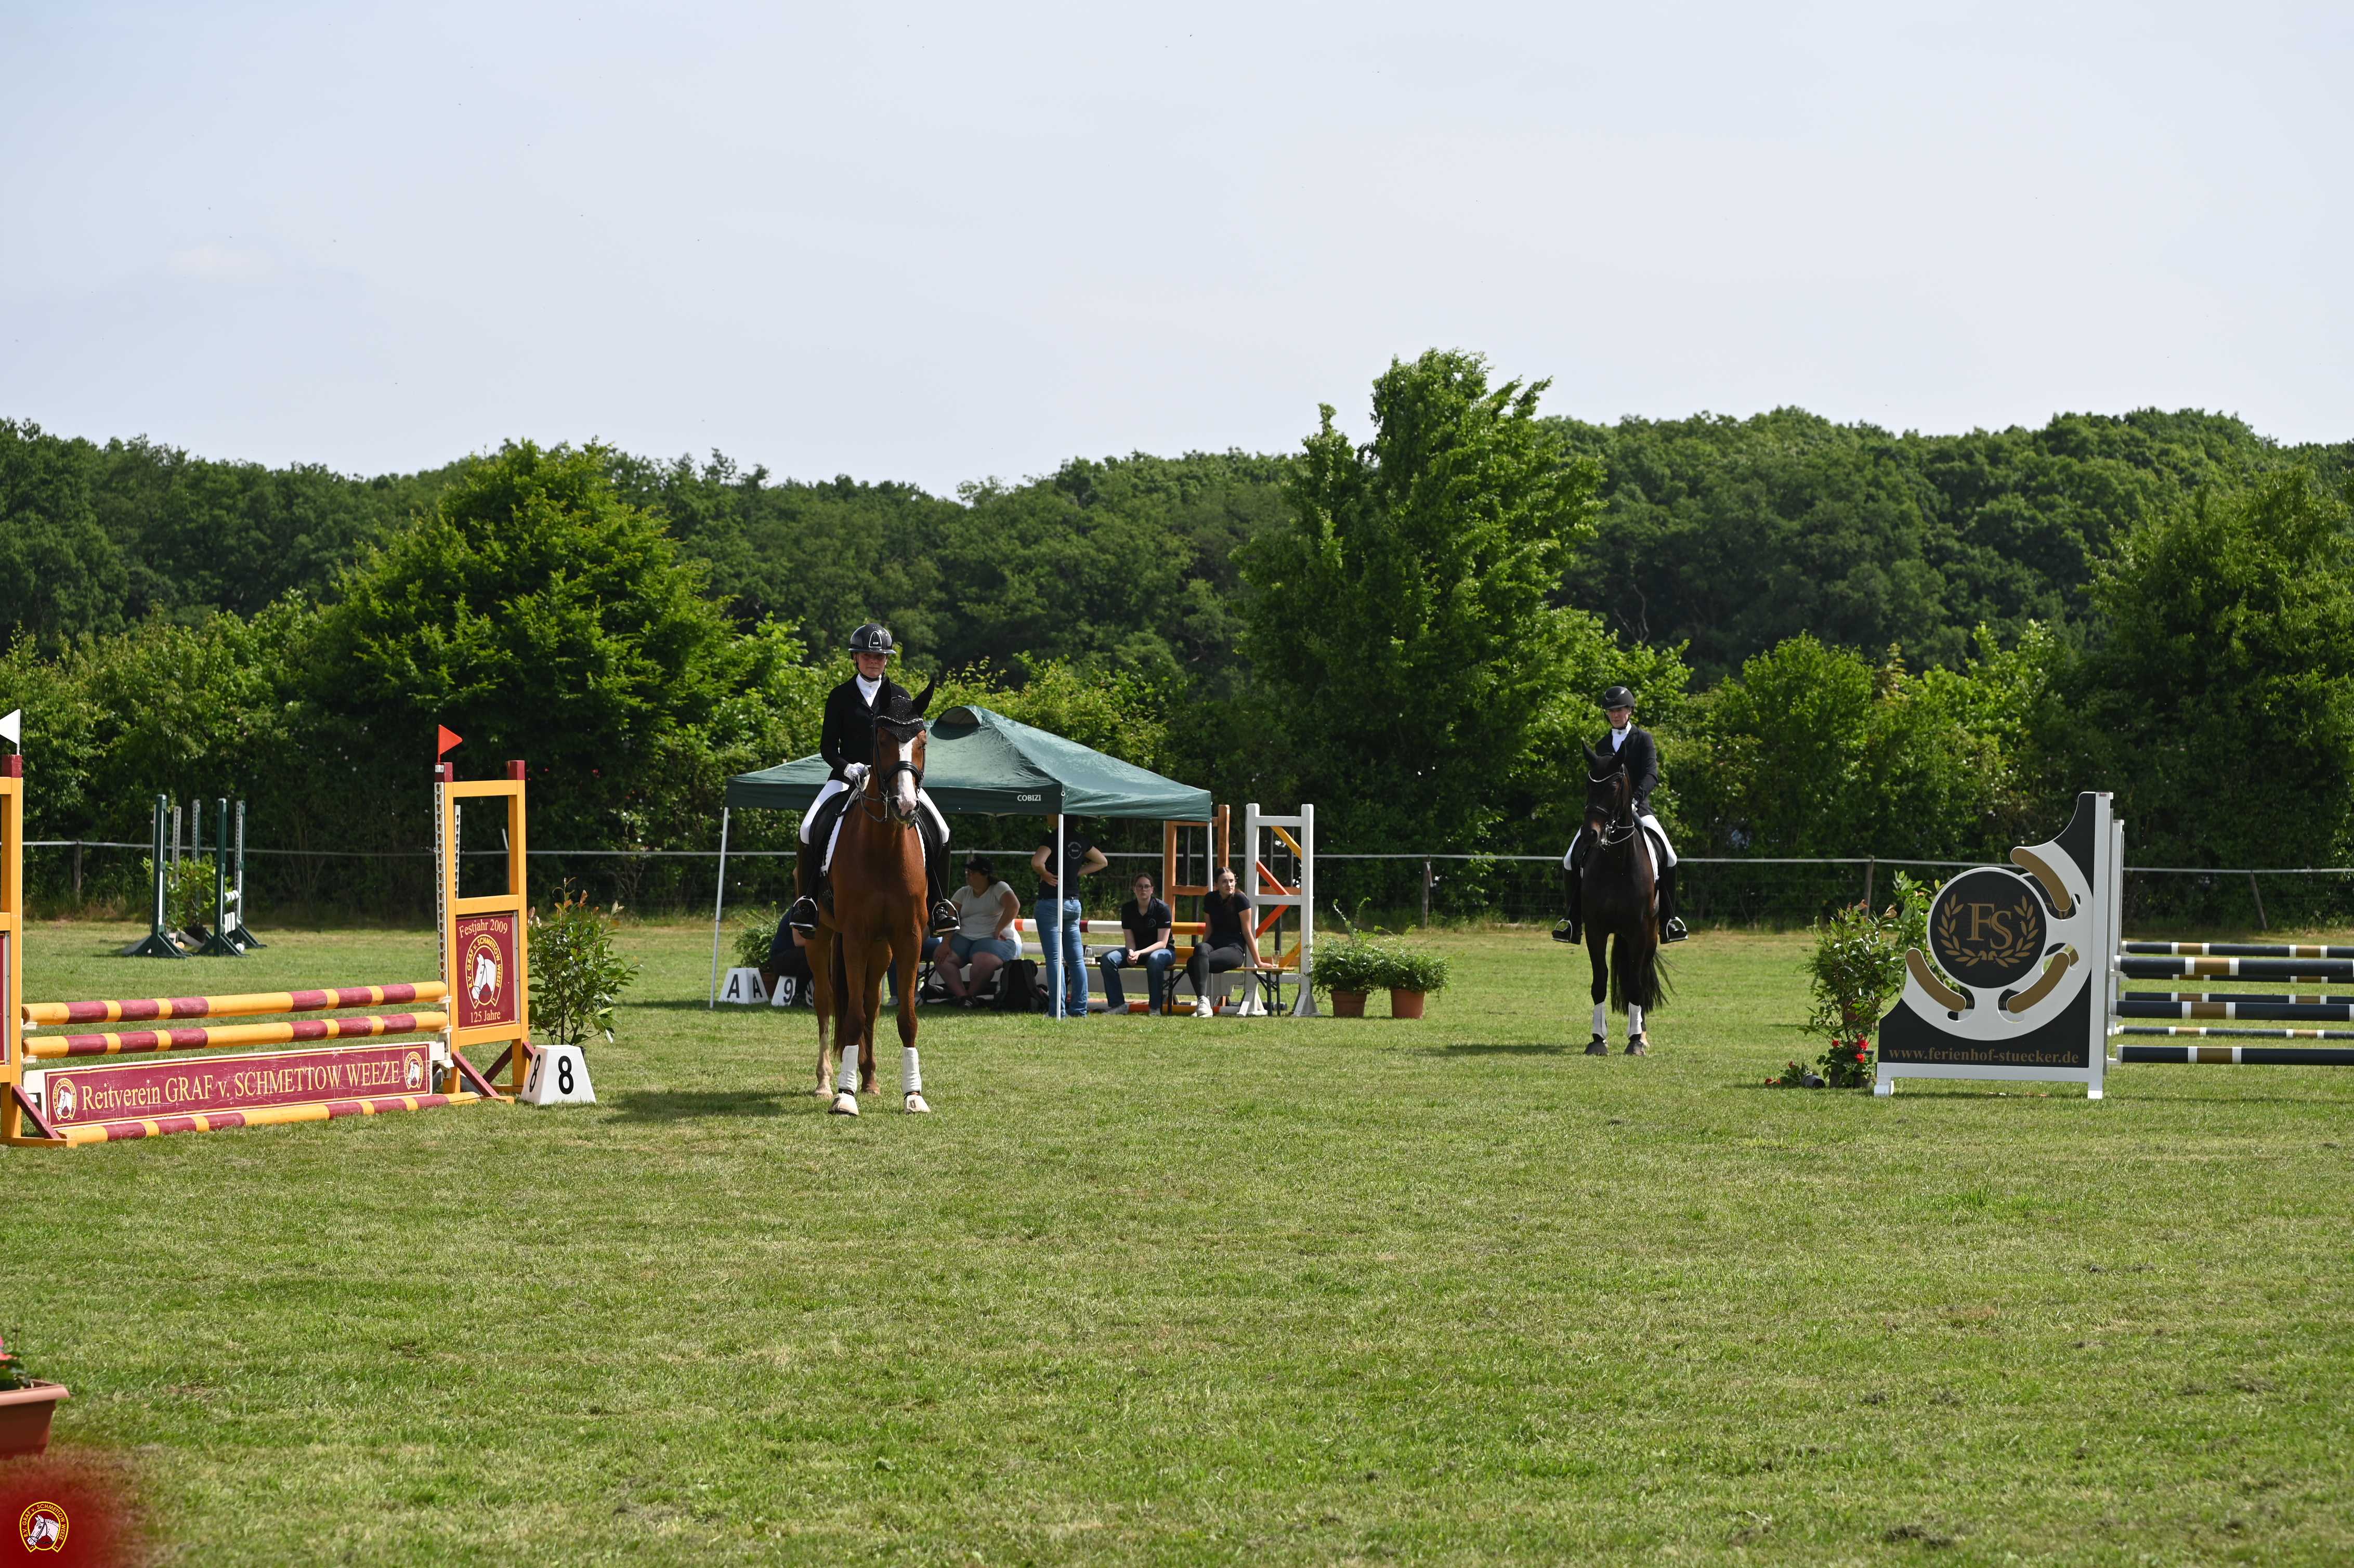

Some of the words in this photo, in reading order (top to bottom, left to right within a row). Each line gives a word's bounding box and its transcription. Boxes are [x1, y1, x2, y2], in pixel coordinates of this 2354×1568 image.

[459, 919, 488, 938] Festjahr
[490, 919, 508, 934] 2009
[1966, 903, 2013, 949] FS
[477, 937, 501, 961] SCHMETTOW
[727, 974, 740, 998] A
[752, 974, 763, 998] A
[783, 978, 793, 1003] 9
[470, 1011, 482, 1023] 125
[483, 1010, 501, 1022] Jahre
[1889, 1047, 2079, 1063] www.ferienhof-stuecker.de
[529, 1054, 541, 1092] 8
[558, 1055, 574, 1094] 8
[82, 1079, 161, 1110] Reitverein
[165, 1075, 213, 1102] GRAF
[217, 1081, 230, 1097] v.
[234, 1064, 343, 1096] SCHMETTOW
[346, 1061, 400, 1087] WEEZE
